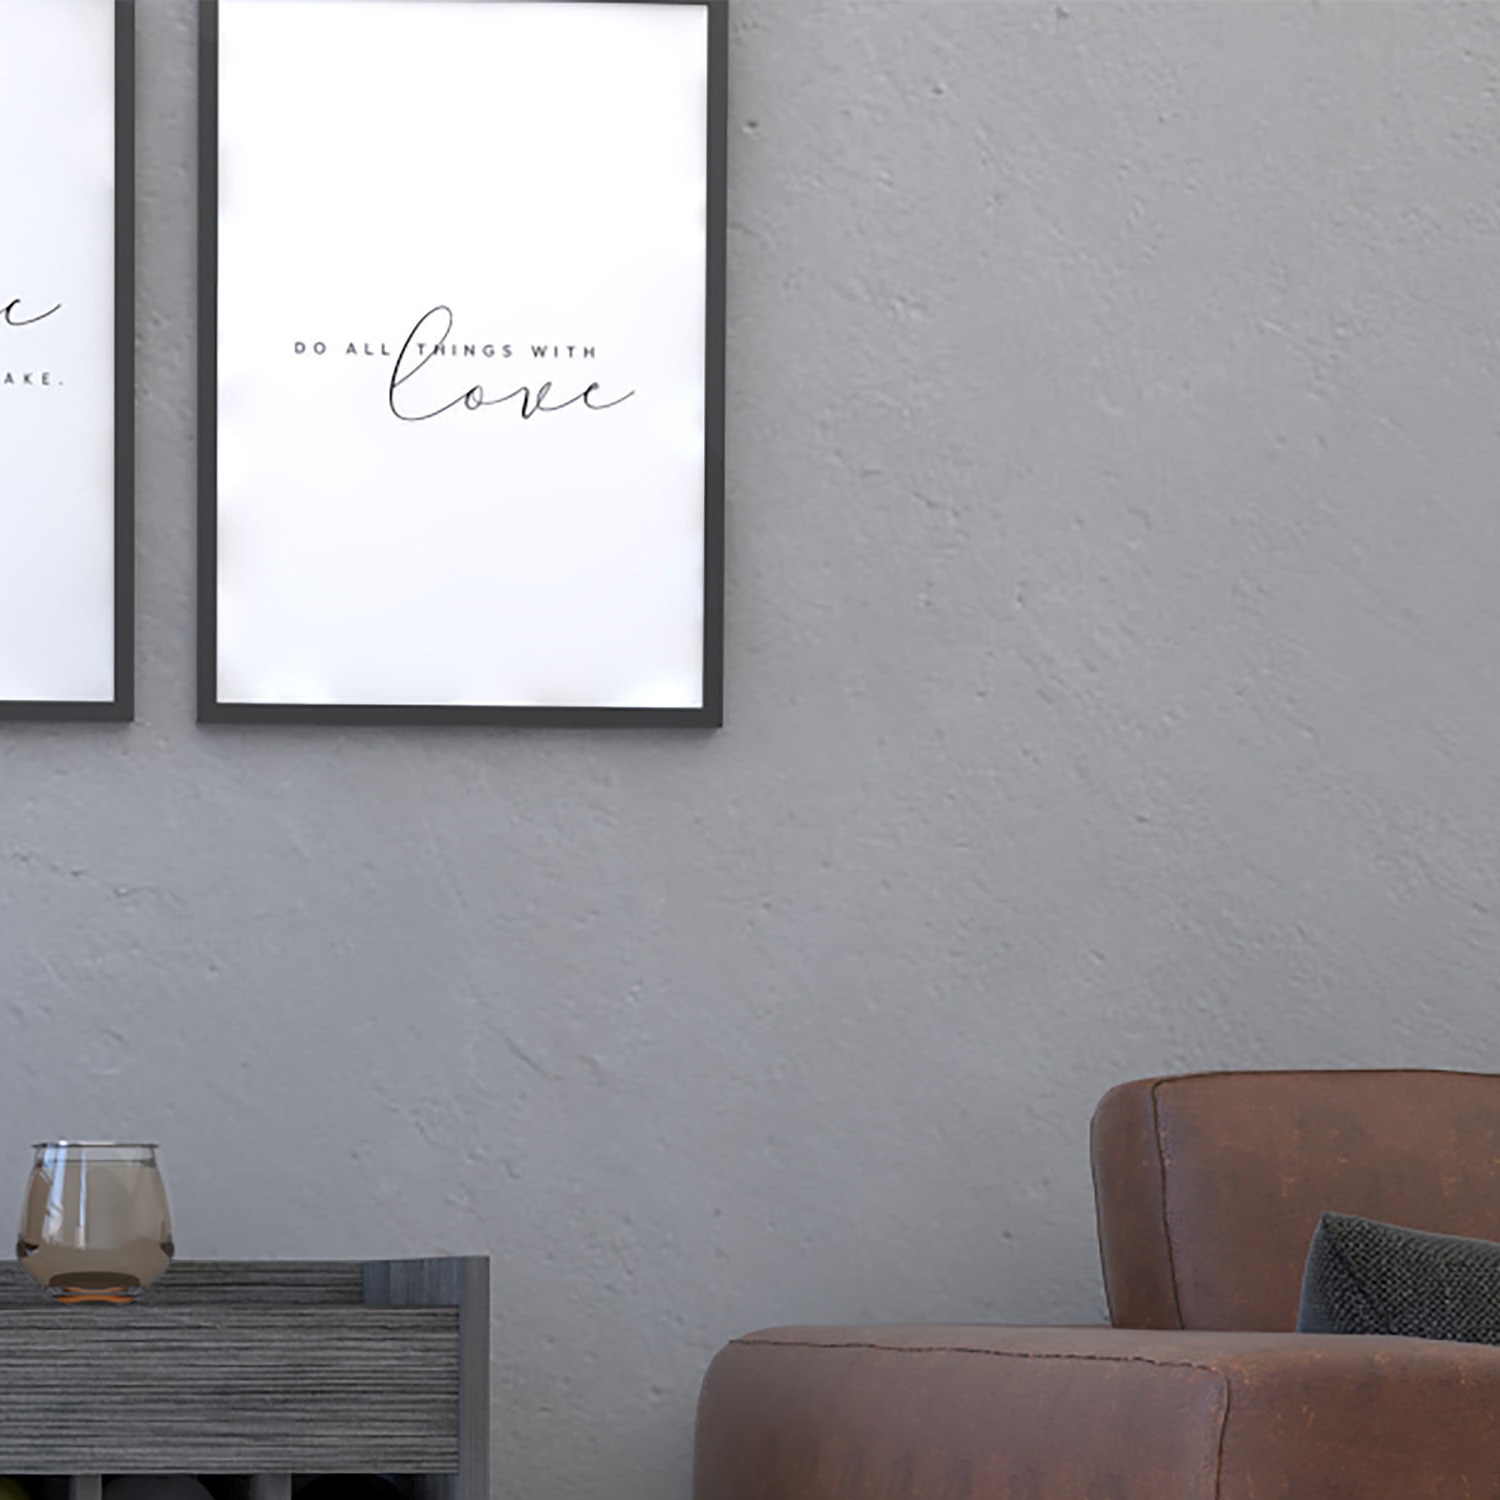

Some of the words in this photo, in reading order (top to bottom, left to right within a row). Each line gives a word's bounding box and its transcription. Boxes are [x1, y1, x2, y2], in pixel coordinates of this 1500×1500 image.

[294, 340, 327, 356] DO
[345, 341, 391, 357] ALL
[417, 342, 513, 359] THINGS
[530, 344, 596, 360] WITH
